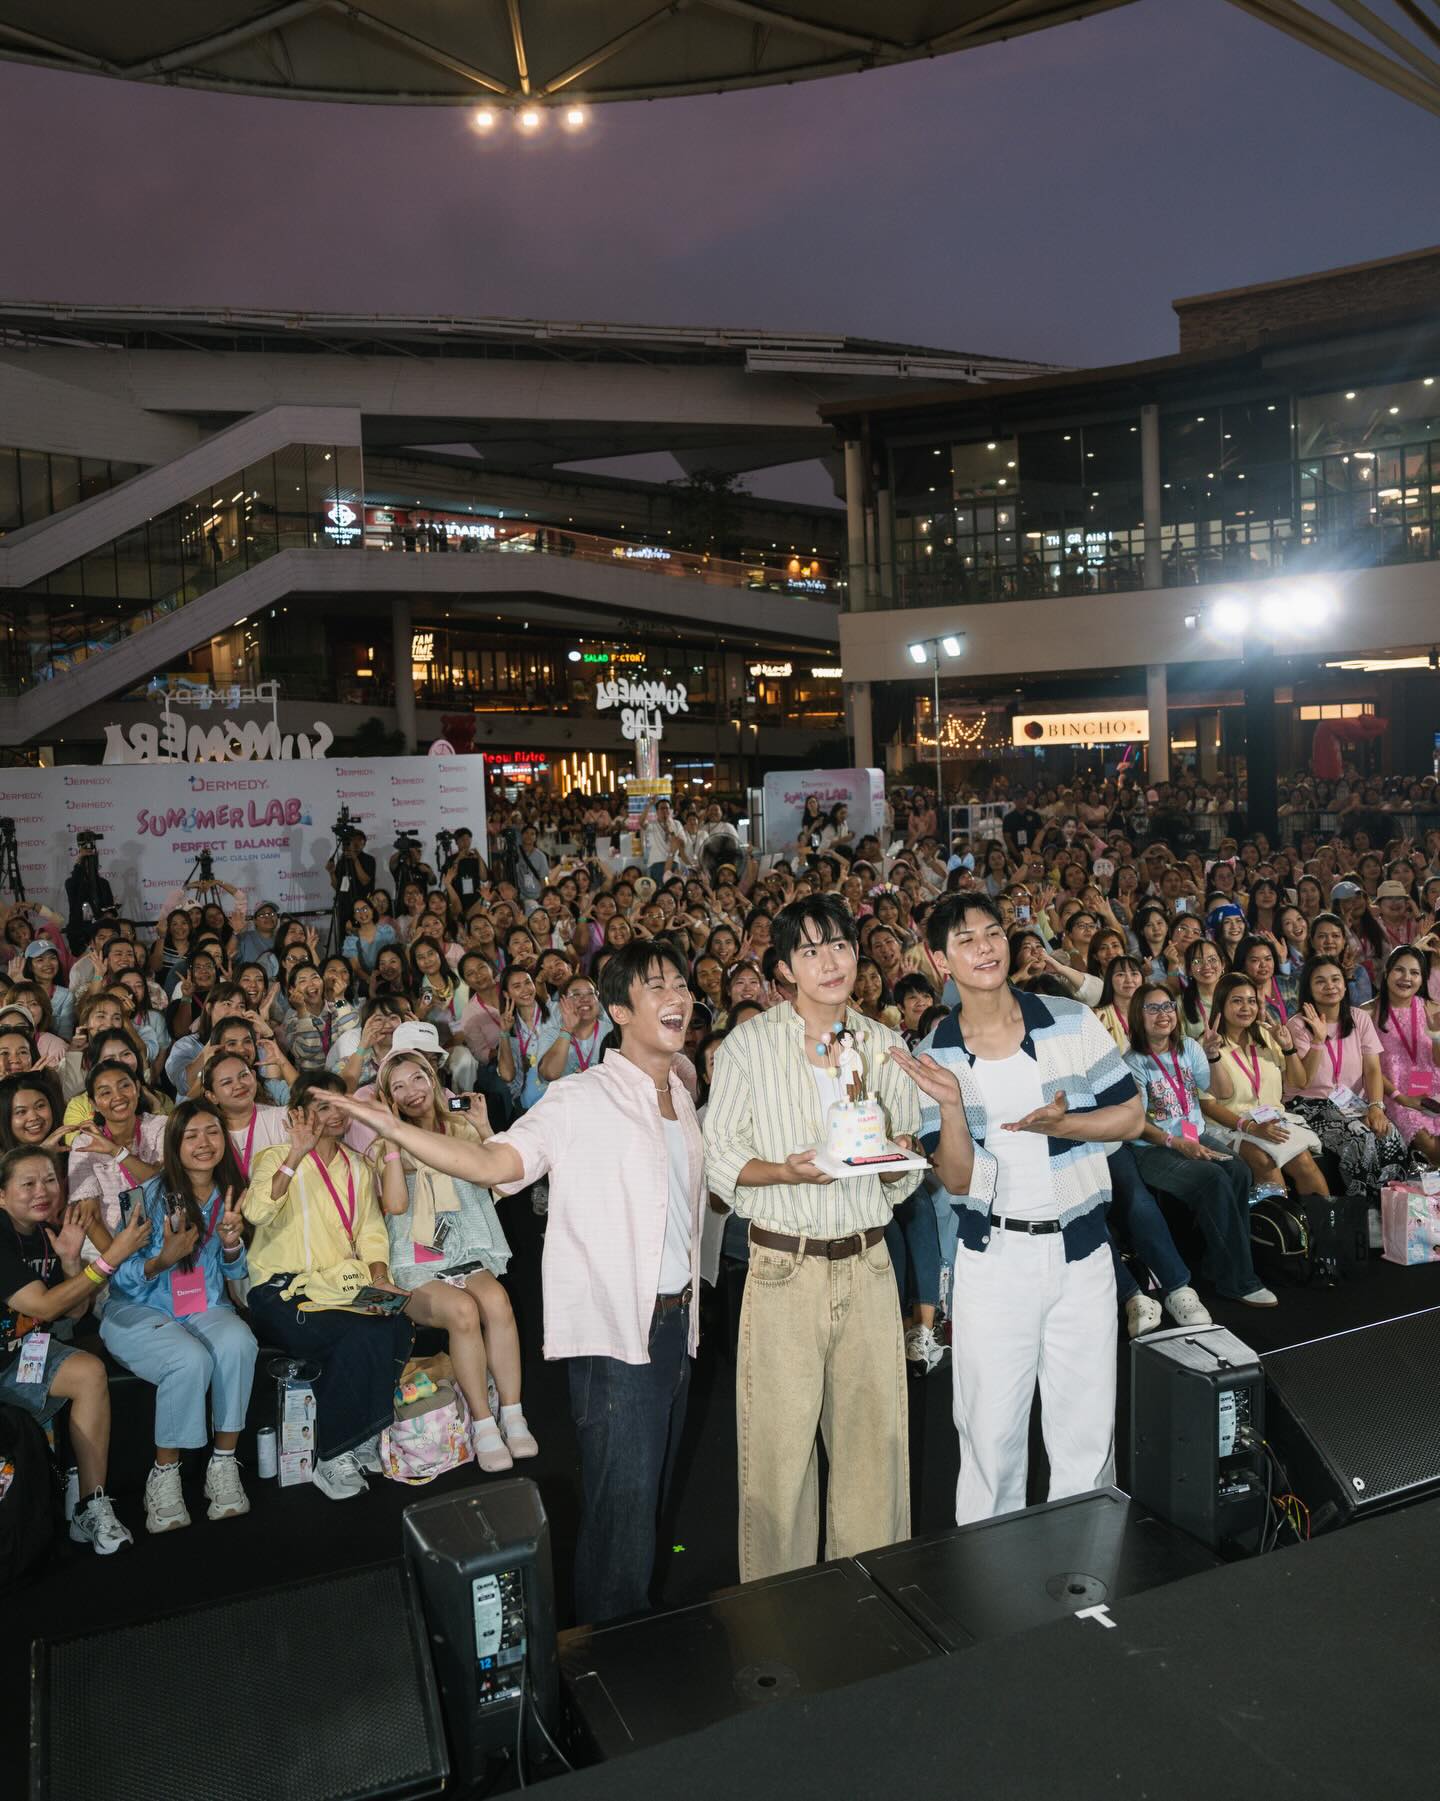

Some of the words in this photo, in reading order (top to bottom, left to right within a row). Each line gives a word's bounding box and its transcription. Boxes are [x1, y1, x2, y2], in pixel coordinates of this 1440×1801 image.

[412, 633, 434, 645] FAM
[412, 644, 434, 656] TIME
[583, 654, 609, 663] SALAD
[1049, 720, 1127, 738] BINCHO
[514, 751, 546, 763] Bistro
[192, 777, 269, 792] DERMEDY
[247, 798, 303, 828] LAB
[172, 840, 228, 852] PERFECT
[234, 836, 290, 850] BALANCE
[479, 1658, 493, 1670] 12
